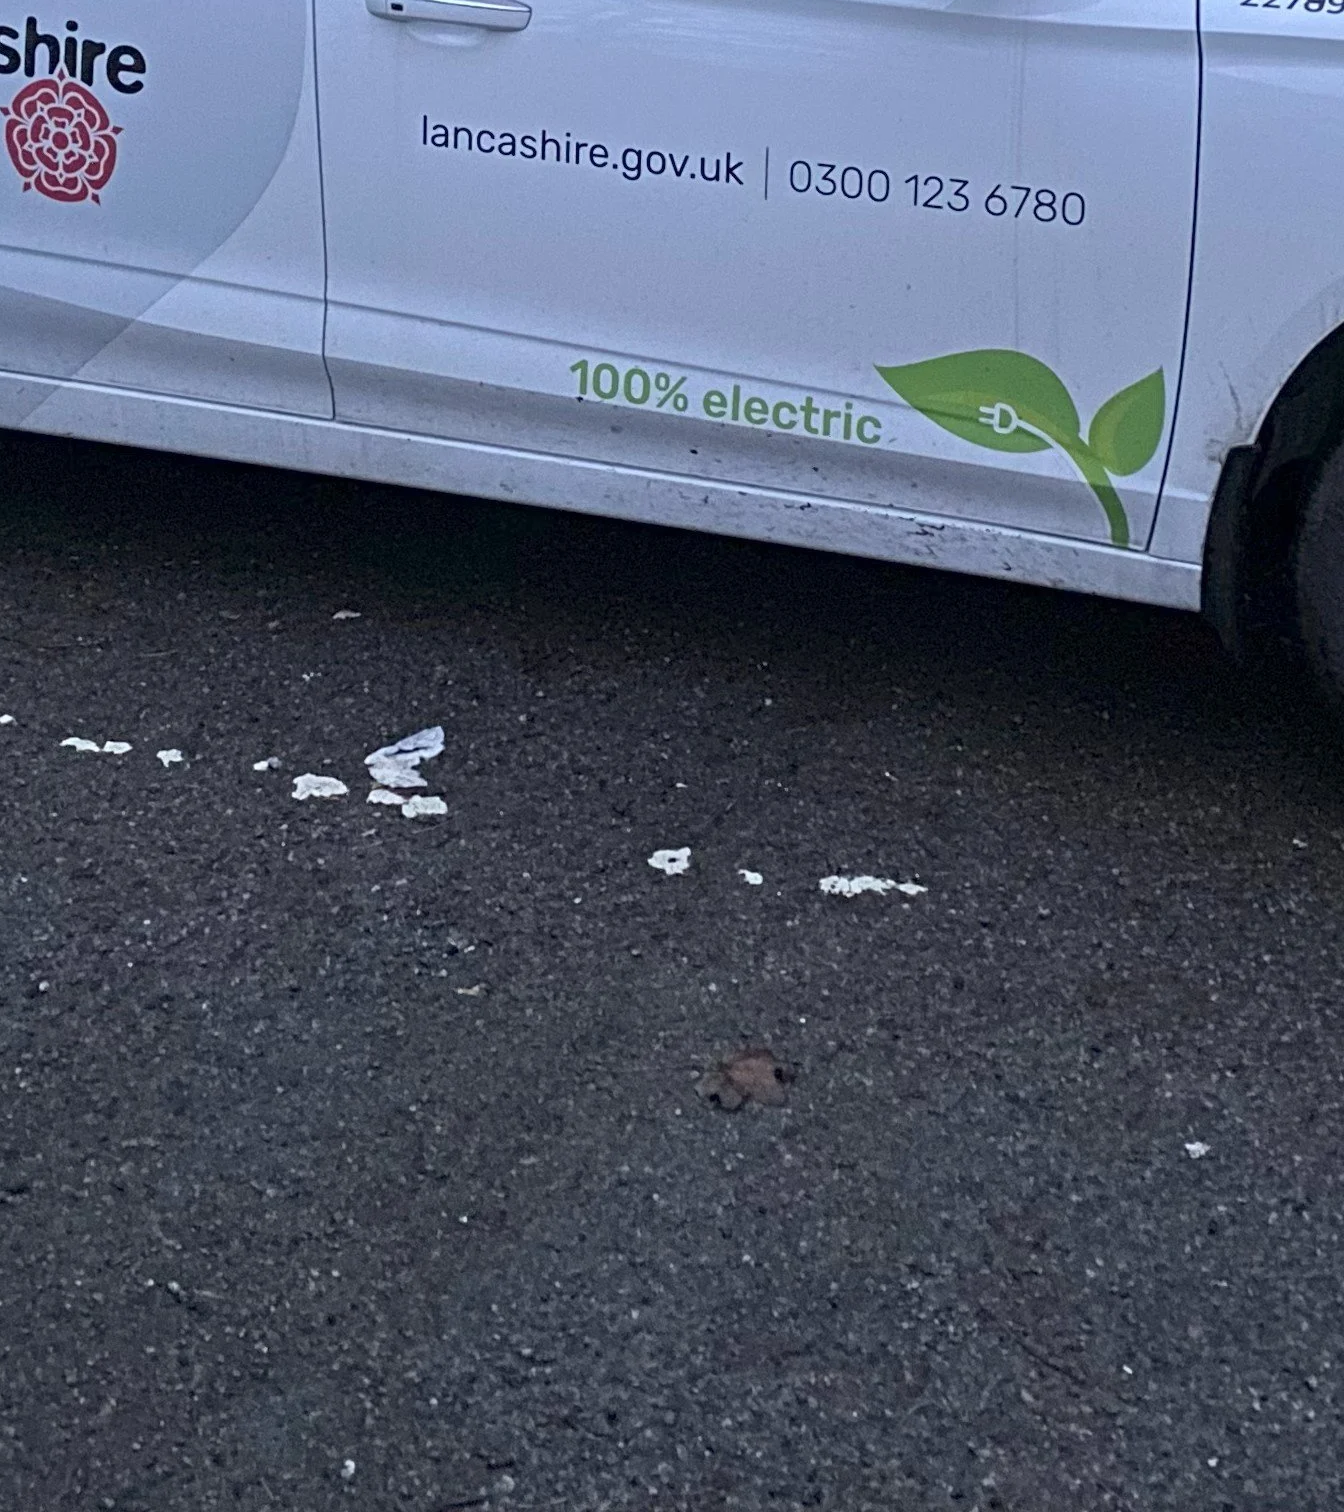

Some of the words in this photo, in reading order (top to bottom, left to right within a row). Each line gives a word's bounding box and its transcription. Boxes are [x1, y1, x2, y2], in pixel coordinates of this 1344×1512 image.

[422, 115, 745, 185] lancashire.gov.uk
[789, 160, 890, 202] 0300
[903, 175, 971, 213] 123
[984, 183, 1087, 227] 6780
[569, 358, 688, 413] 100%
[703, 383, 883, 445] electric
